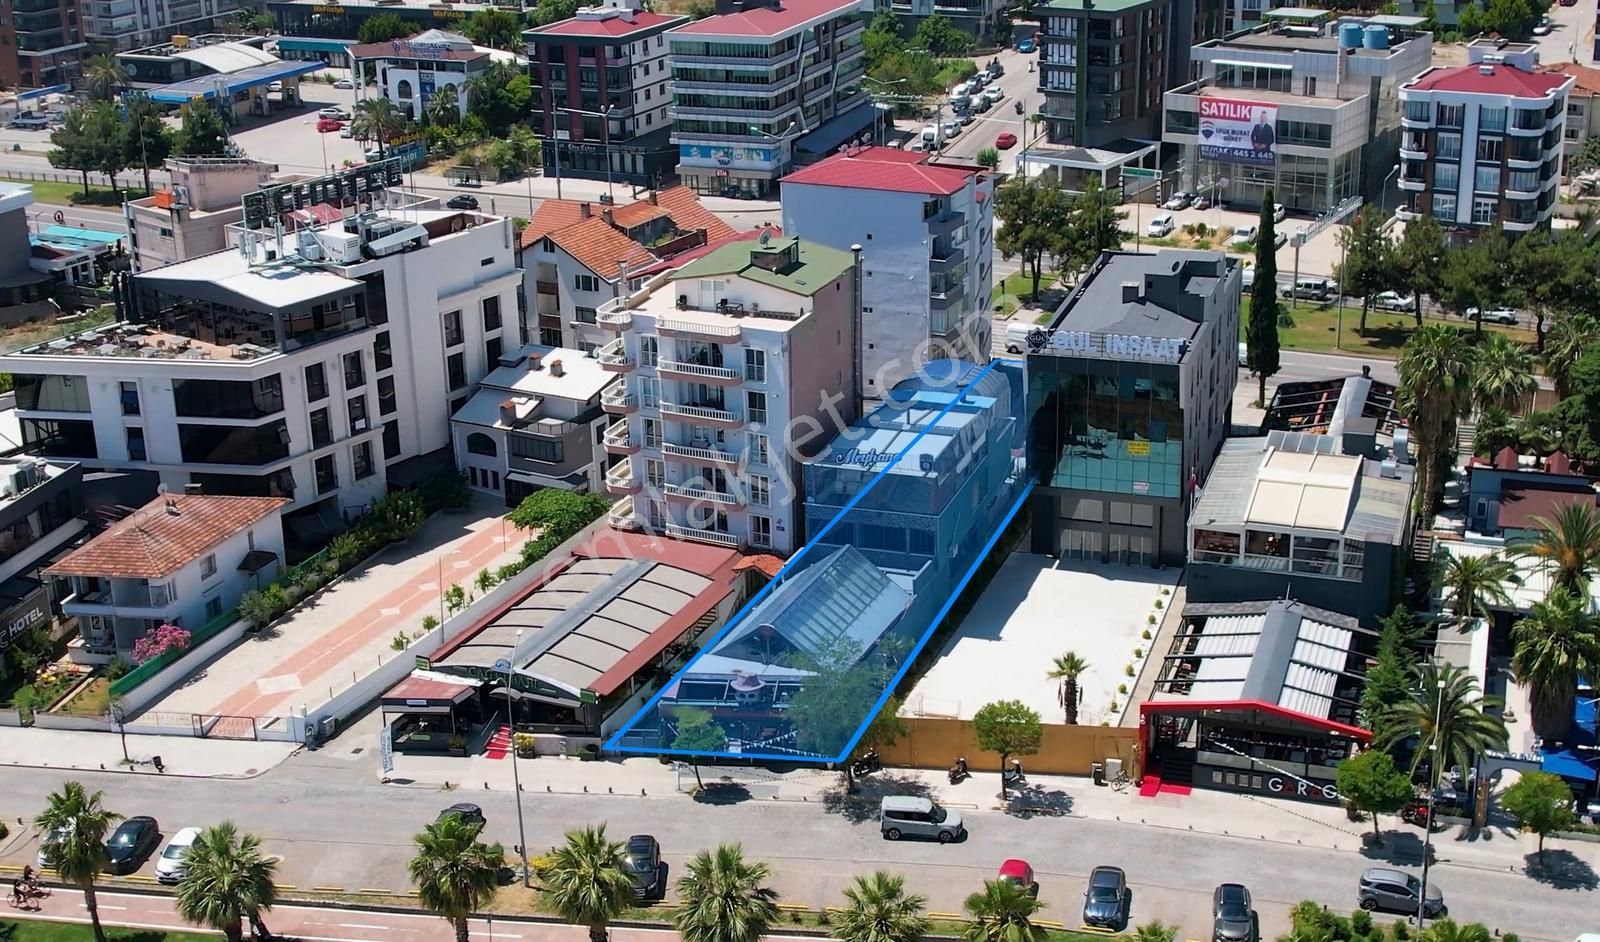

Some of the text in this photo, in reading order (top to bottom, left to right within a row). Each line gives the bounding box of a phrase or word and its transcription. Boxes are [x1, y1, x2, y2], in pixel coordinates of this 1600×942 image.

[1201, 101, 1251, 119] SATILIK
[1233, 149, 1249, 157] 445
[1257, 151, 1274, 159] 445
[836, 447, 902, 471] Meyhan
[8, 607, 44, 637] HOTEL
[1268, 777, 1338, 799] GARAG
